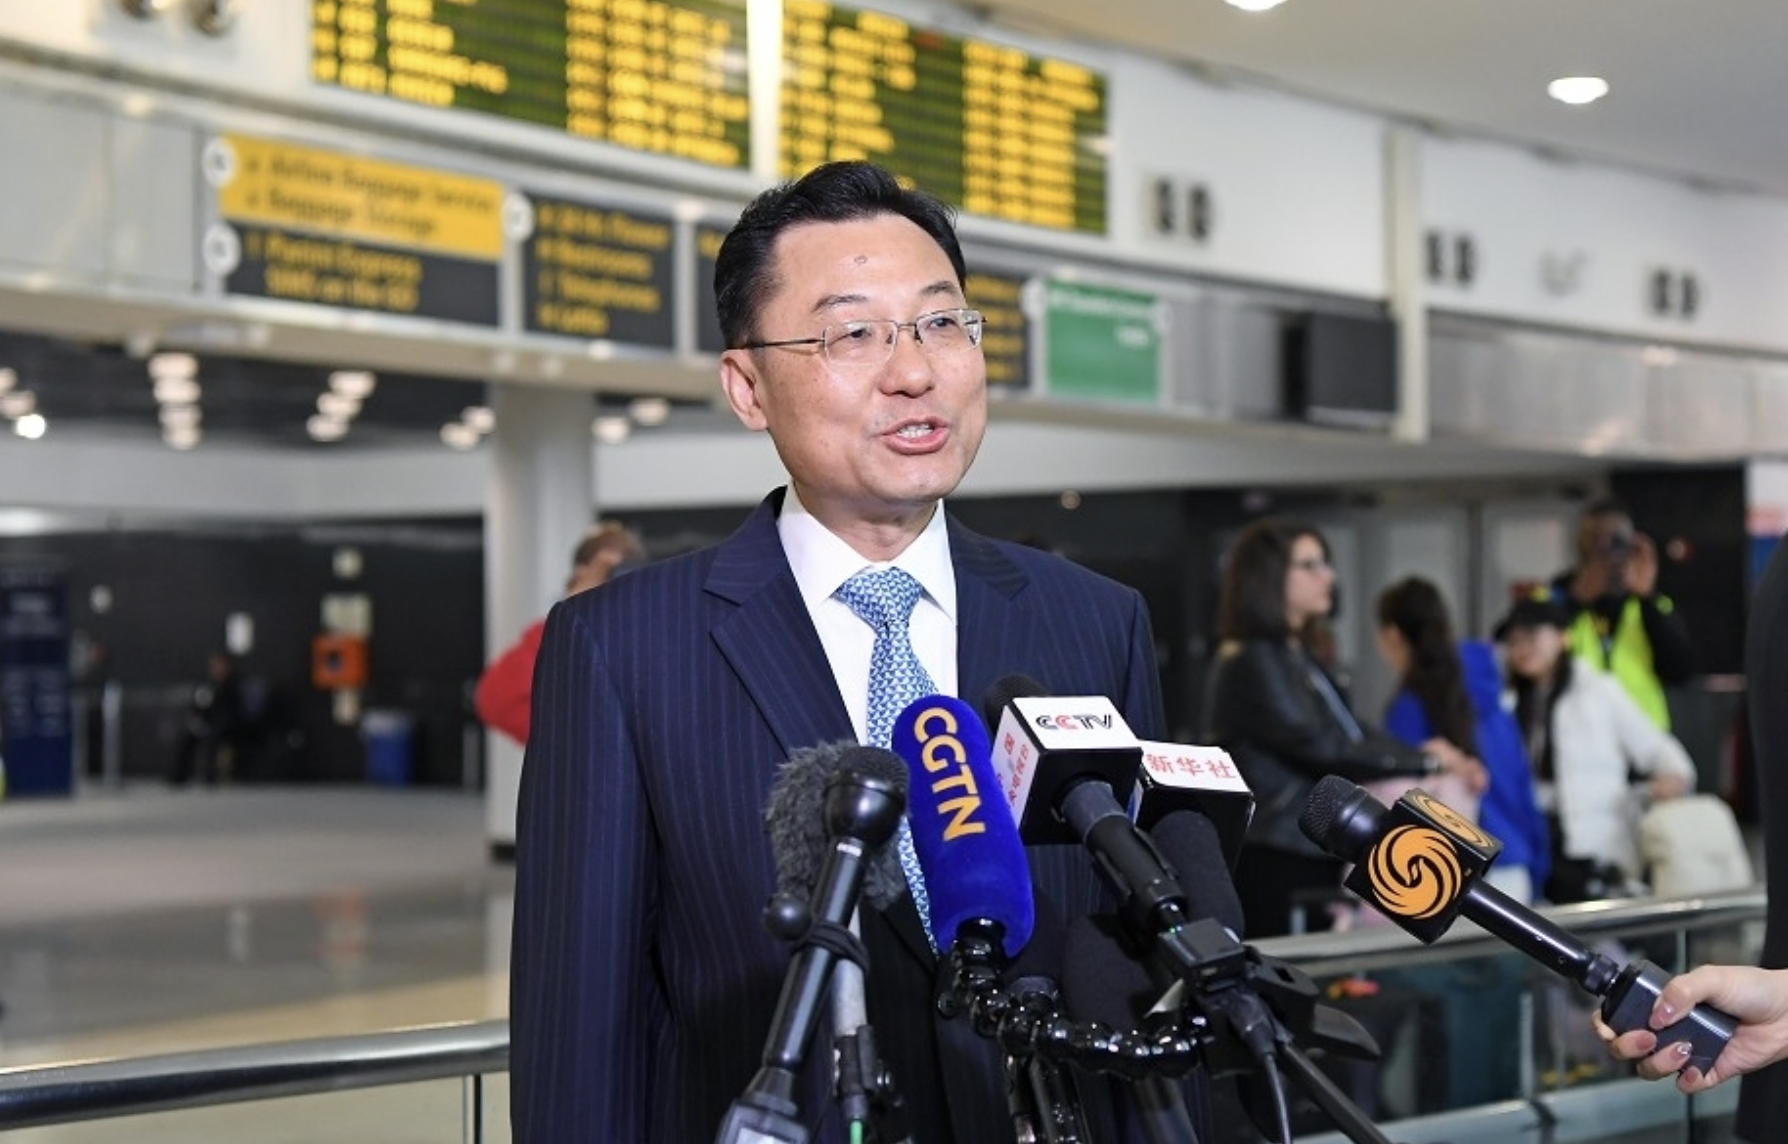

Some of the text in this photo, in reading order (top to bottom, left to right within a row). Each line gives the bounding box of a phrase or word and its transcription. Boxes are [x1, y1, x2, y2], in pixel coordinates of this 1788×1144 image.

[1036, 713, 1112, 730] CCTV
[914, 707, 986, 842] CGTN
[1146, 754, 1236, 778] 新华社
